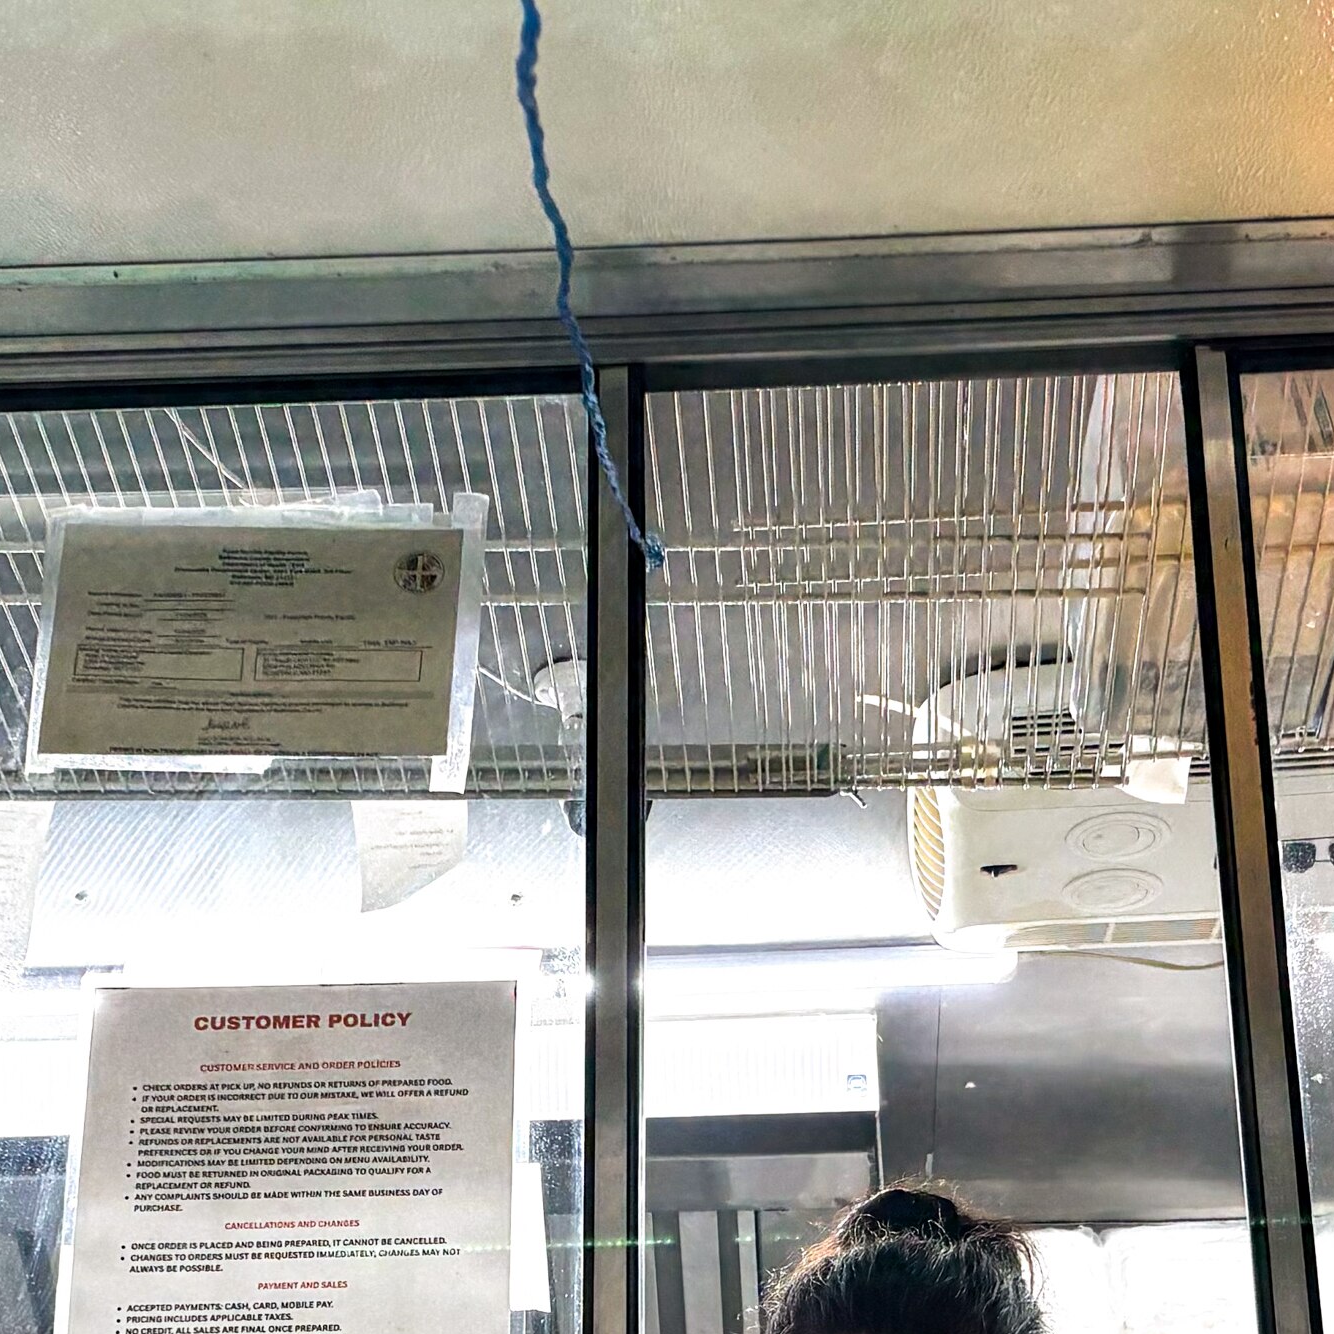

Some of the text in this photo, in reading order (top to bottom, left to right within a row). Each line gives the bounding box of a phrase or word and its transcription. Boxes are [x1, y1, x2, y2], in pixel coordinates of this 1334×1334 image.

[195, 1012, 412, 1030] CUSTOMER POLICY
[200, 1064, 254, 1072] CUSTOMER
[322, 1061, 355, 1069] ORDER
[357, 1060, 400, 1068] POLICIES
[225, 1221, 295, 1229] CANCELLATIONS
[258, 1282, 298, 1290] PAYMENT
[127, 1304, 172, 1312] ACCEPTED
[225, 1303, 251, 1311] CASH,
[253, 1302, 279, 1310] CARD,
[281, 1301, 314, 1309] MOBILE
